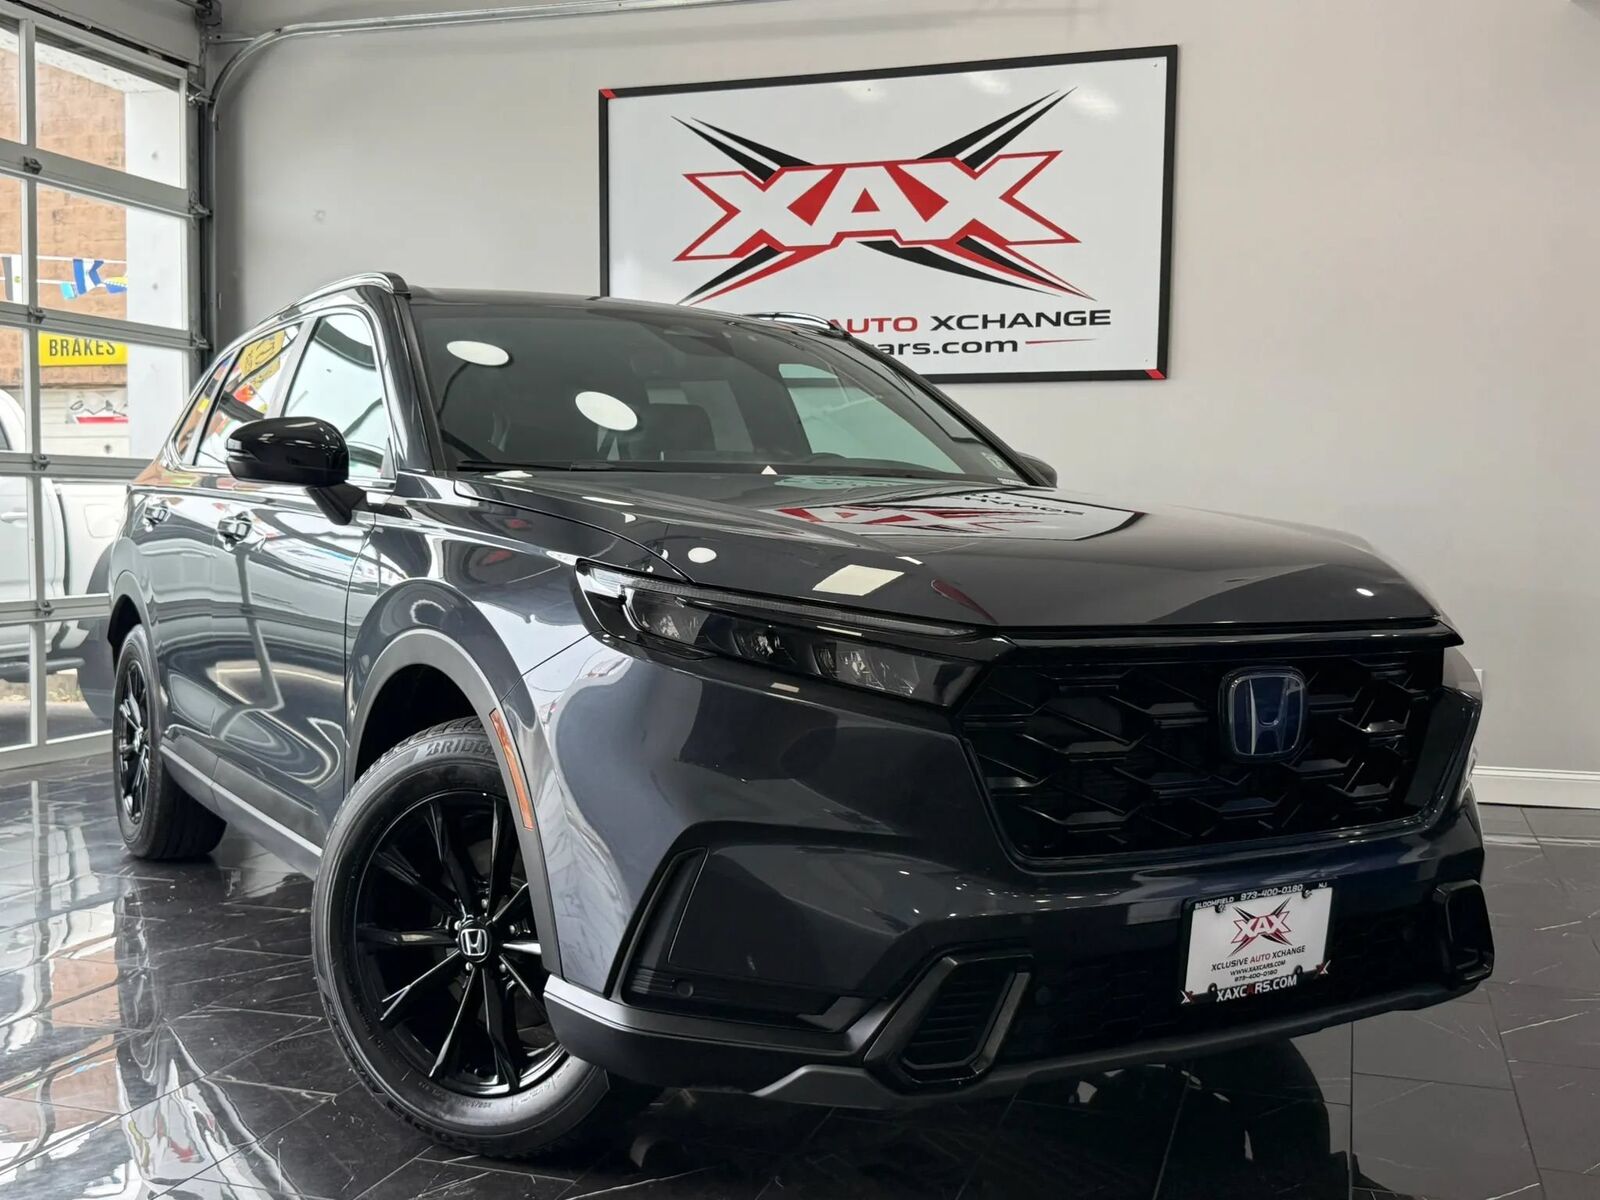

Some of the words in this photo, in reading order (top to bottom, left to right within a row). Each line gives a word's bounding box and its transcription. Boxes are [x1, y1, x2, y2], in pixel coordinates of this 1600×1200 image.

[674, 150, 1081, 261] XAX
[930, 309, 1111, 331] XCHANGE
[49, 338, 116, 357] BRAKES
[872, 339, 1018, 355] ars.com
[1240, 884, 1303, 901] 973-400-0180
[1231, 911, 1291, 944] XAX
[1211, 957, 1249, 972] XCLUSIVE
[1250, 953, 1271, 964] AUTO
[1272, 945, 1306, 959] XCHANGE
[1230, 960, 1286, 976] WWW.XAXCARS.COM
[1216, 975, 1297, 1002] XAXCARS.COM
